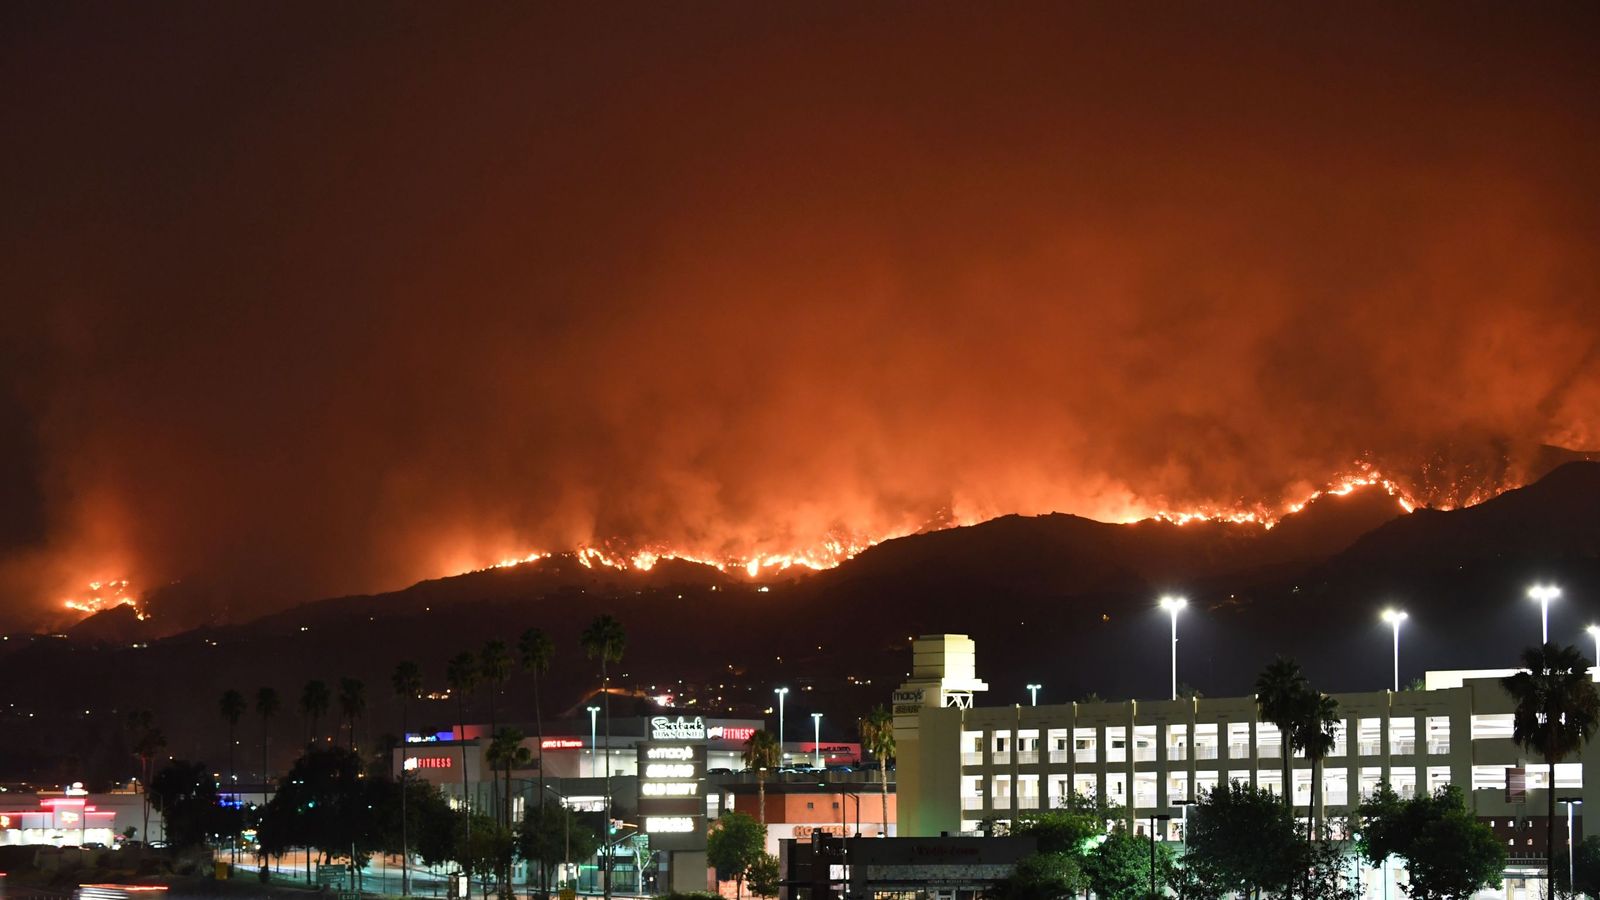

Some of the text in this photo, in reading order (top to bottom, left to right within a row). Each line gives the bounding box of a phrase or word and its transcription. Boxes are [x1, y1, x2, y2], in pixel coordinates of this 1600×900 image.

[893, 688, 923, 702] macy's
[652, 717, 704, 730] Burbank
[723, 728, 755, 740] FITNESS
[418, 757, 451, 768] FITNESS
[795, 825, 850, 836] HOTERS
